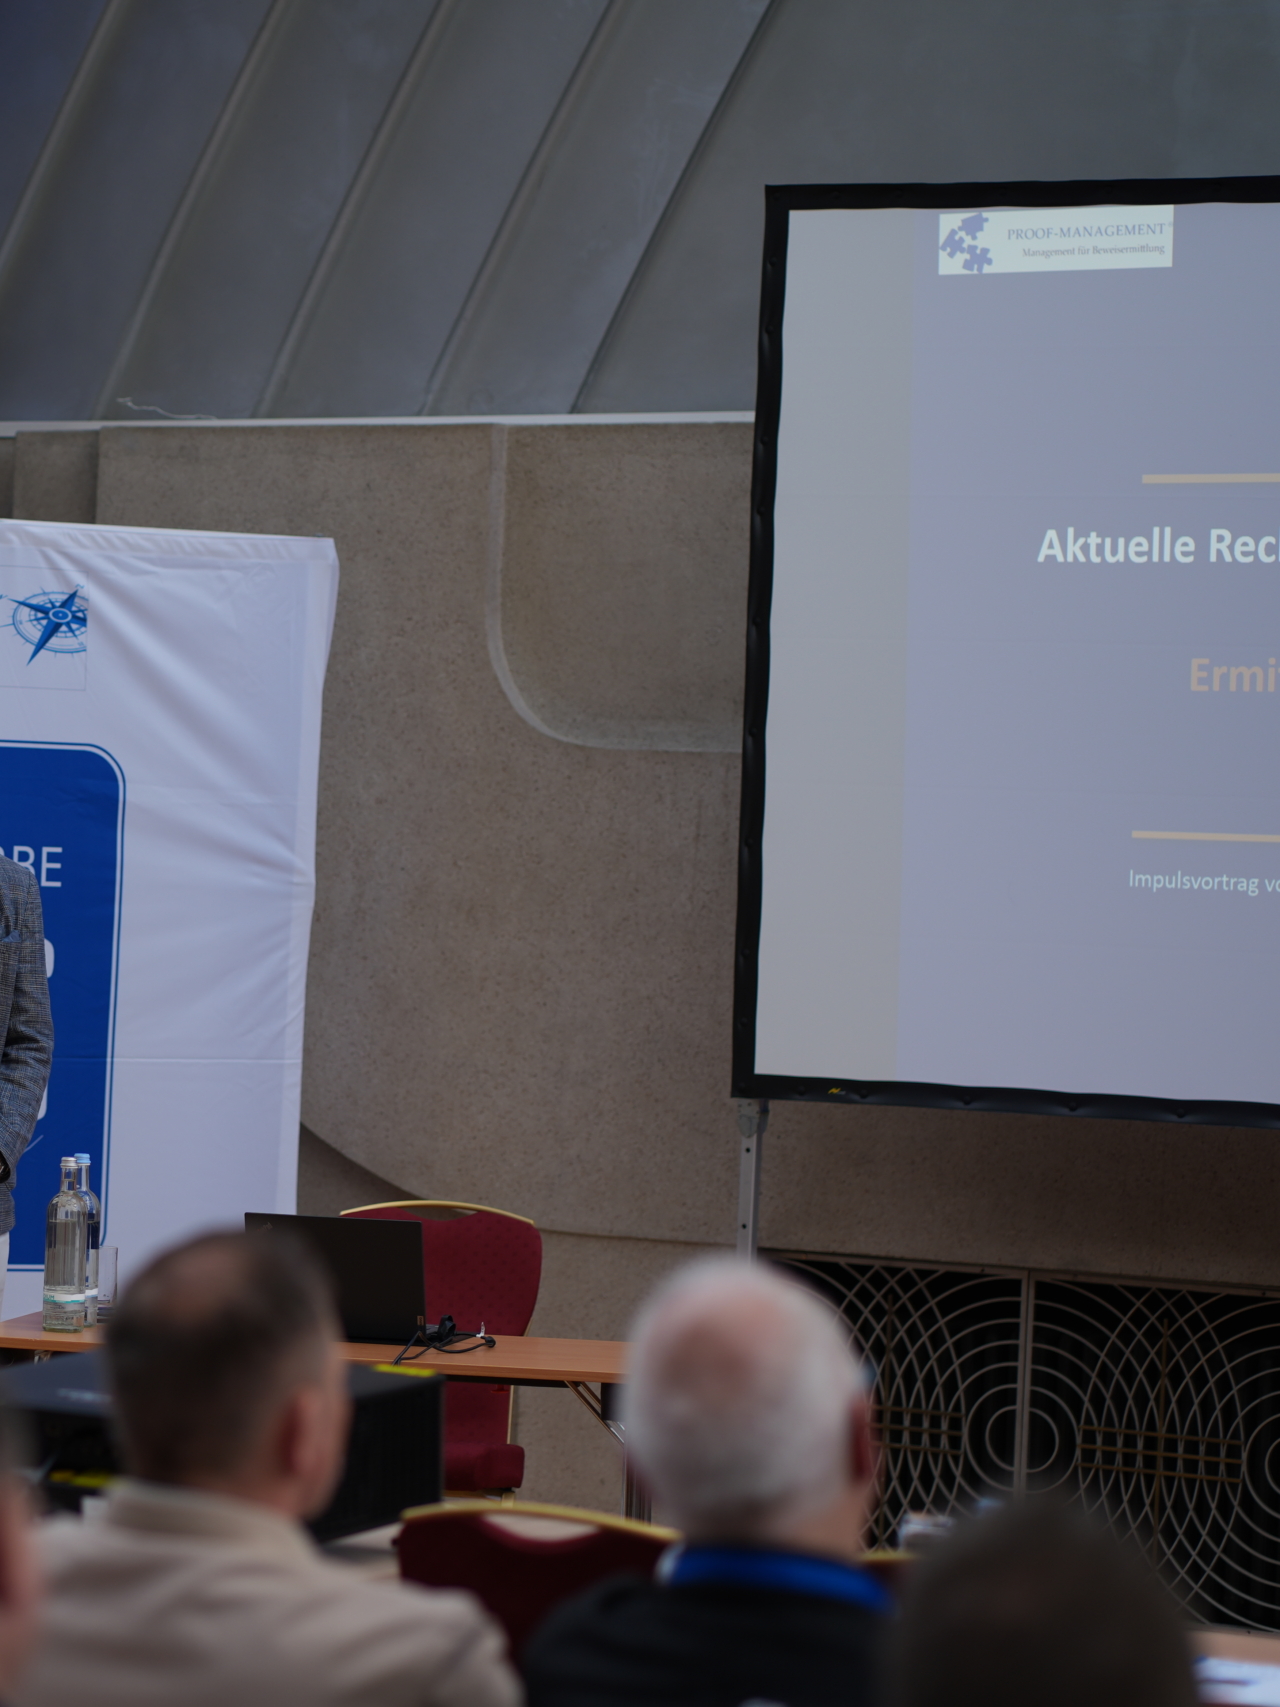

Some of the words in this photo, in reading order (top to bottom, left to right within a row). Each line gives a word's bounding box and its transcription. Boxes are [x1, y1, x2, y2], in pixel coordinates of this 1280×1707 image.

[1007, 223, 1166, 240] PROOF-MANAGEMENT
[1022, 247, 1075, 259] Management
[1077, 245, 1090, 256] für
[1092, 243, 1165, 256] Beweisermittlung
[1037, 527, 1196, 564] Aktuelle
[1209, 526, 1280, 564] Rec
[1190, 657, 1280, 693] Ermi
[1129, 868, 1260, 897] Impulsvortrag
